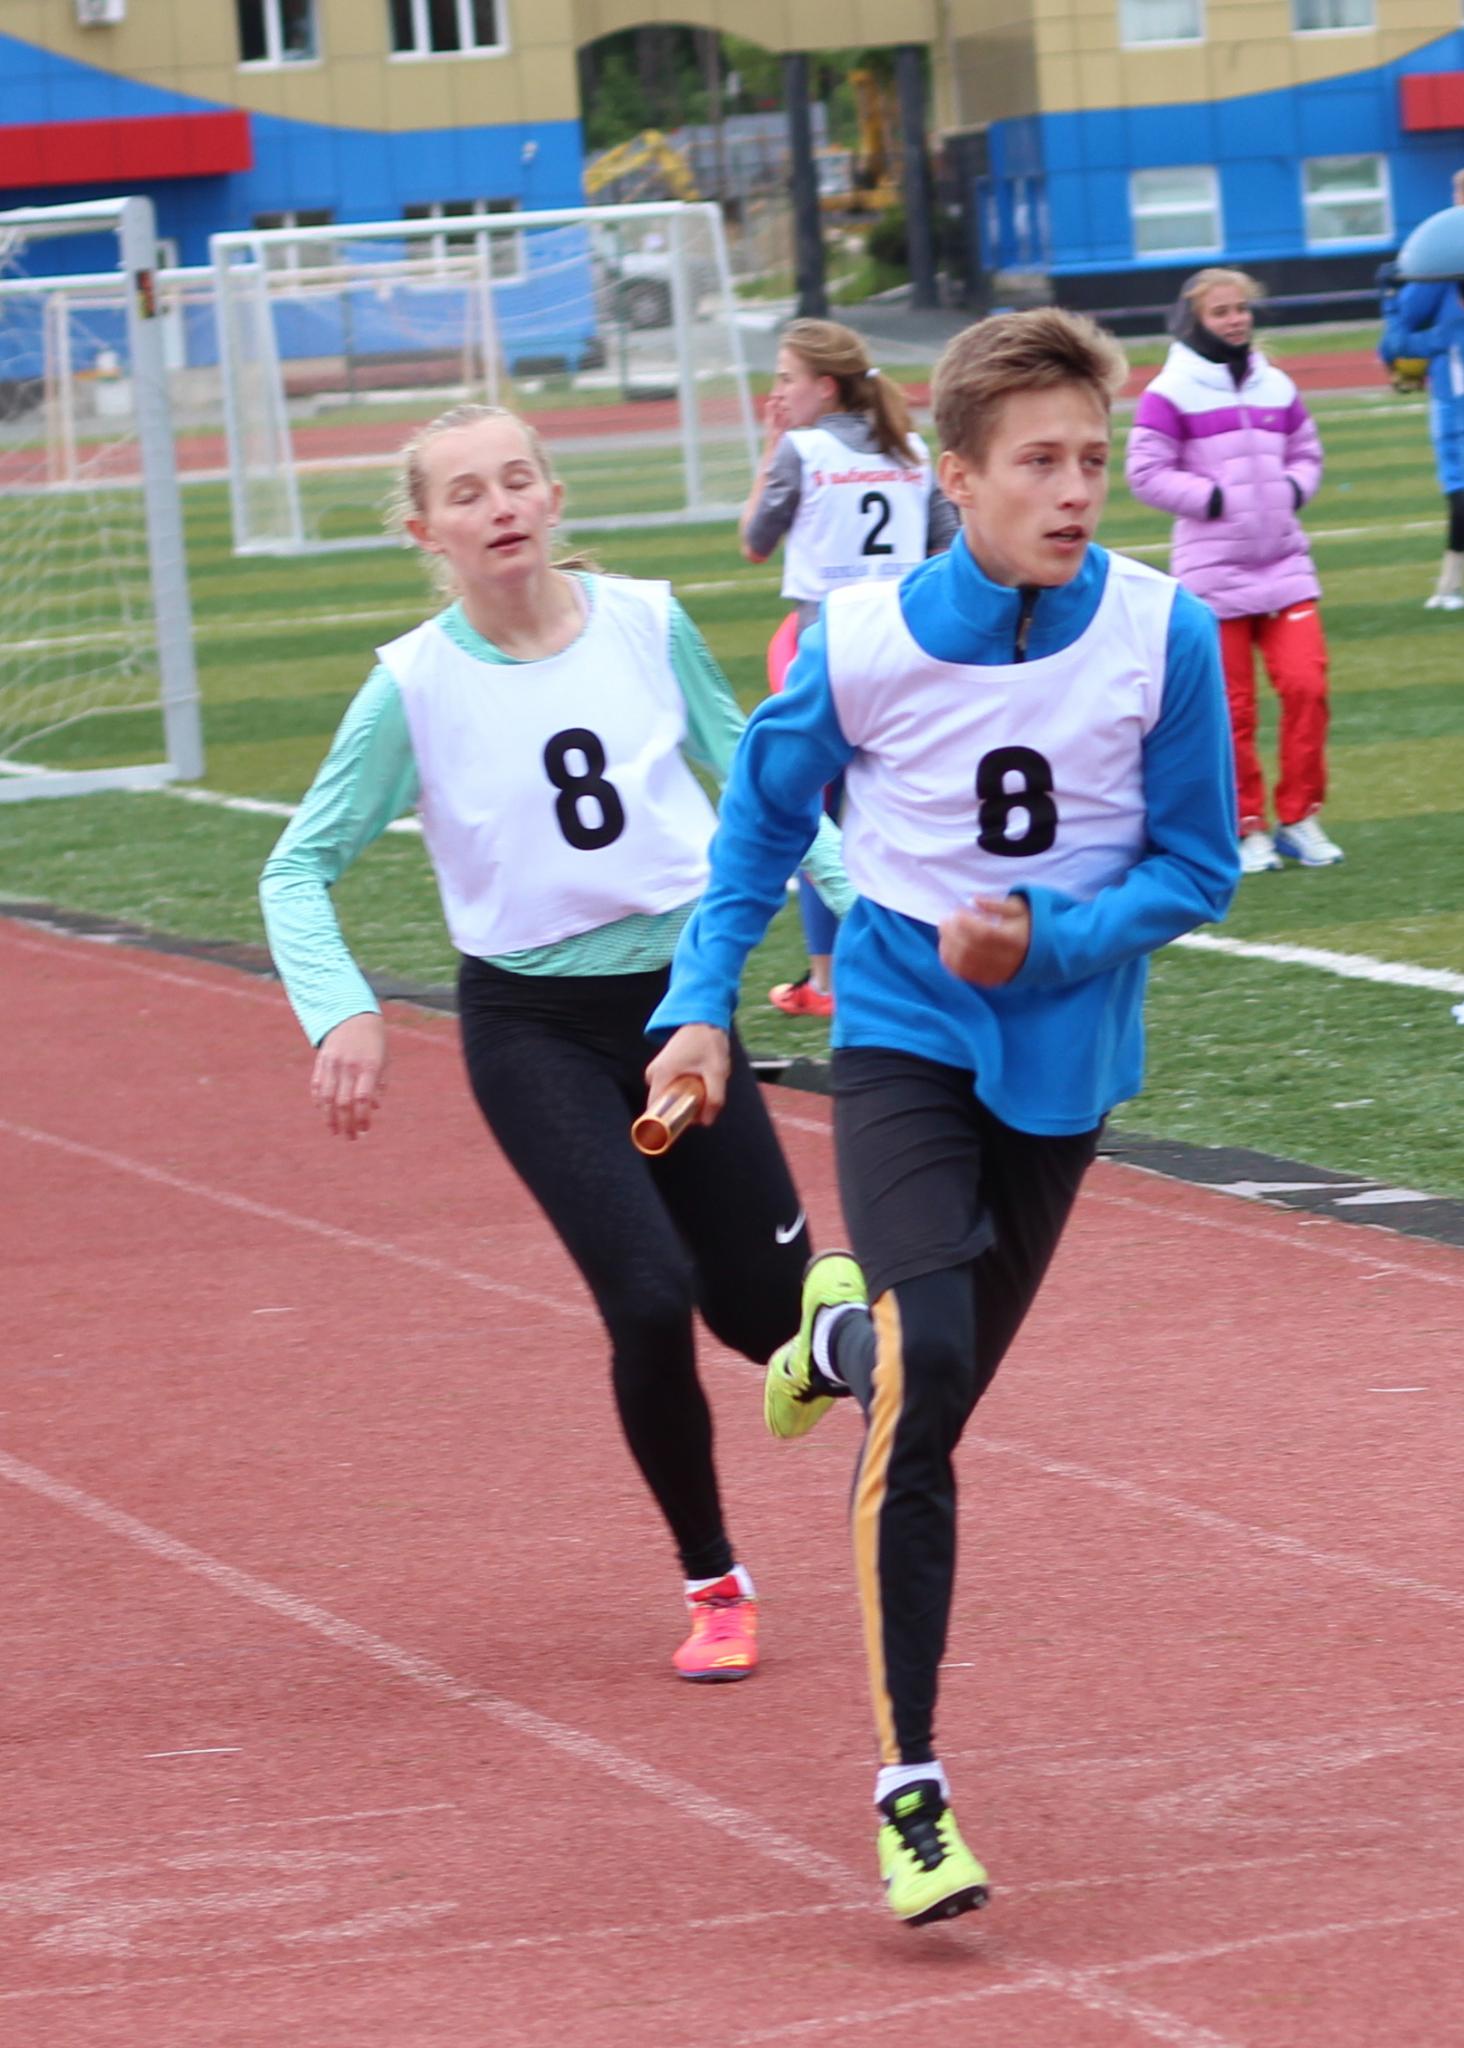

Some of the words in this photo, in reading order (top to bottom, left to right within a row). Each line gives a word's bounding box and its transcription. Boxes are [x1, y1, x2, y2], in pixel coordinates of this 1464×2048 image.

[860, 491, 894, 556] 2
[543, 727, 626, 851] 8
[975, 746, 1059, 857] 8
